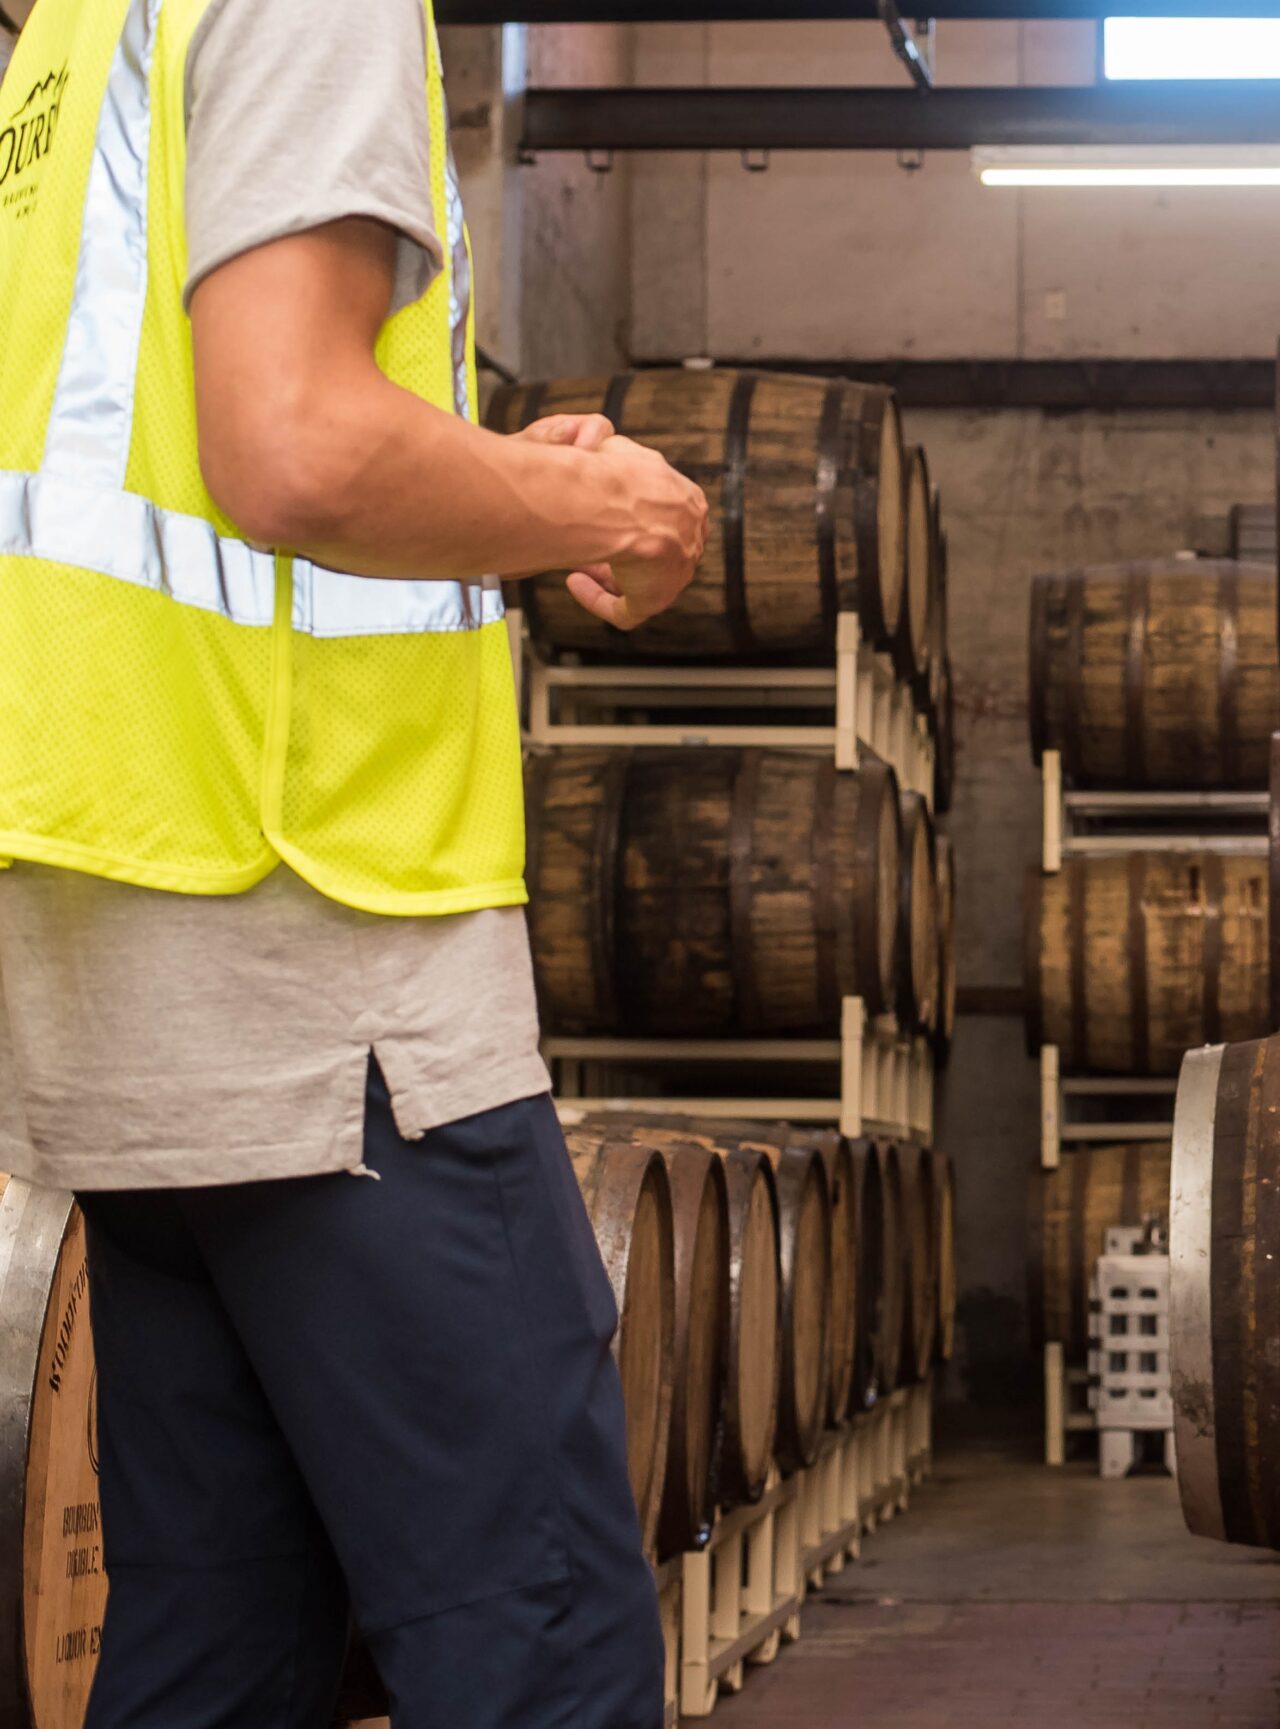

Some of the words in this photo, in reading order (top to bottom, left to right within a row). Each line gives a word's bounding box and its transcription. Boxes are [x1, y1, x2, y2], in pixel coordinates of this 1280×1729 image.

[0, 113, 45, 186] OUR
[63, 1502, 99, 1538] BOURBON
[66, 1545, 99, 1579] DOUBLE
[55, 1628, 87, 1664] LIQUOR
